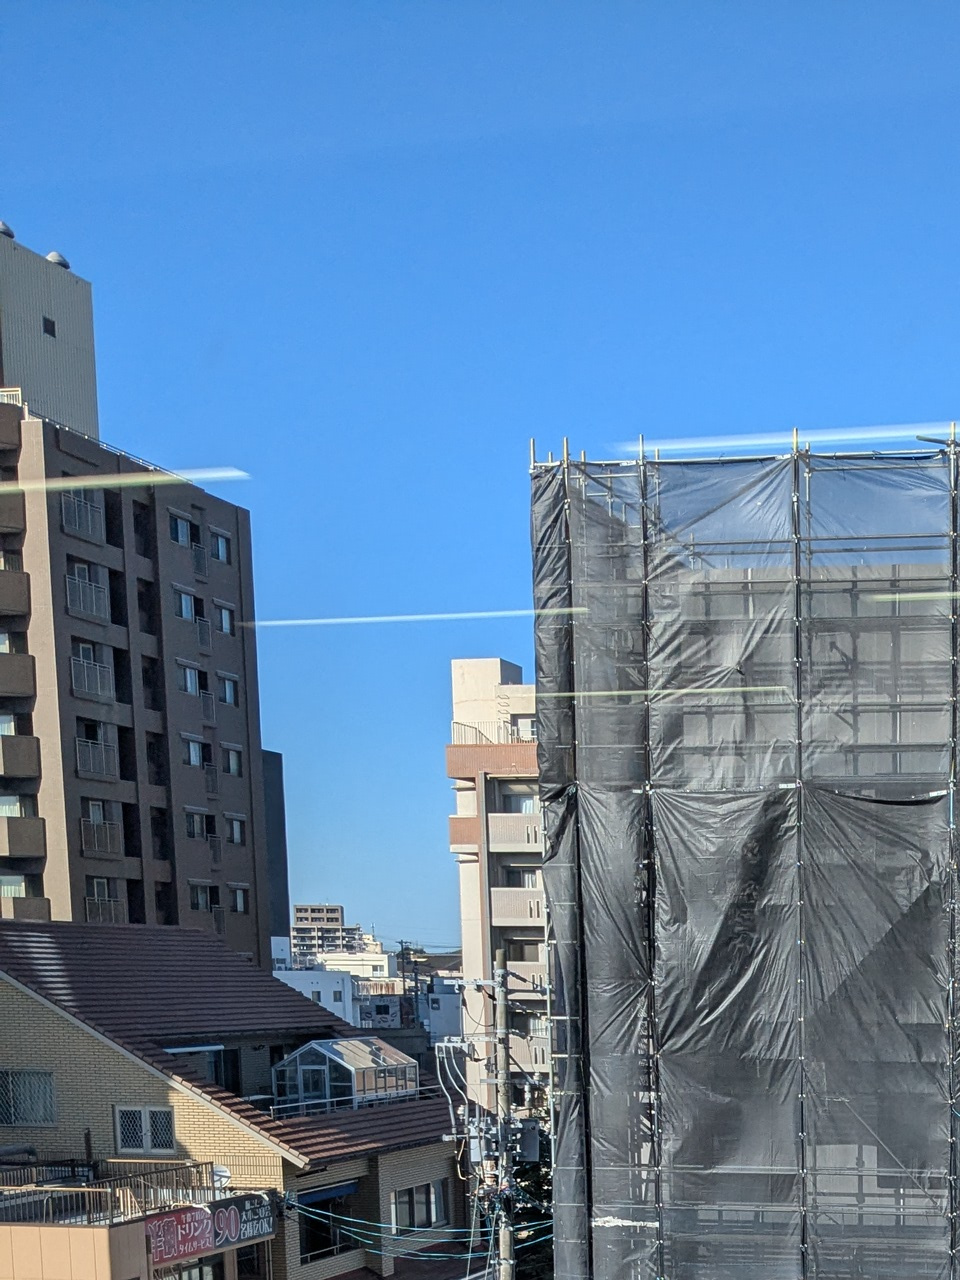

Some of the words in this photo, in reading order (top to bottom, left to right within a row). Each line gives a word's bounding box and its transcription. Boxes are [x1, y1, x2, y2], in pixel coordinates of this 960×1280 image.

[177, 1219, 211, 1241] ドリンク
[214, 1205, 240, 1246] 90
